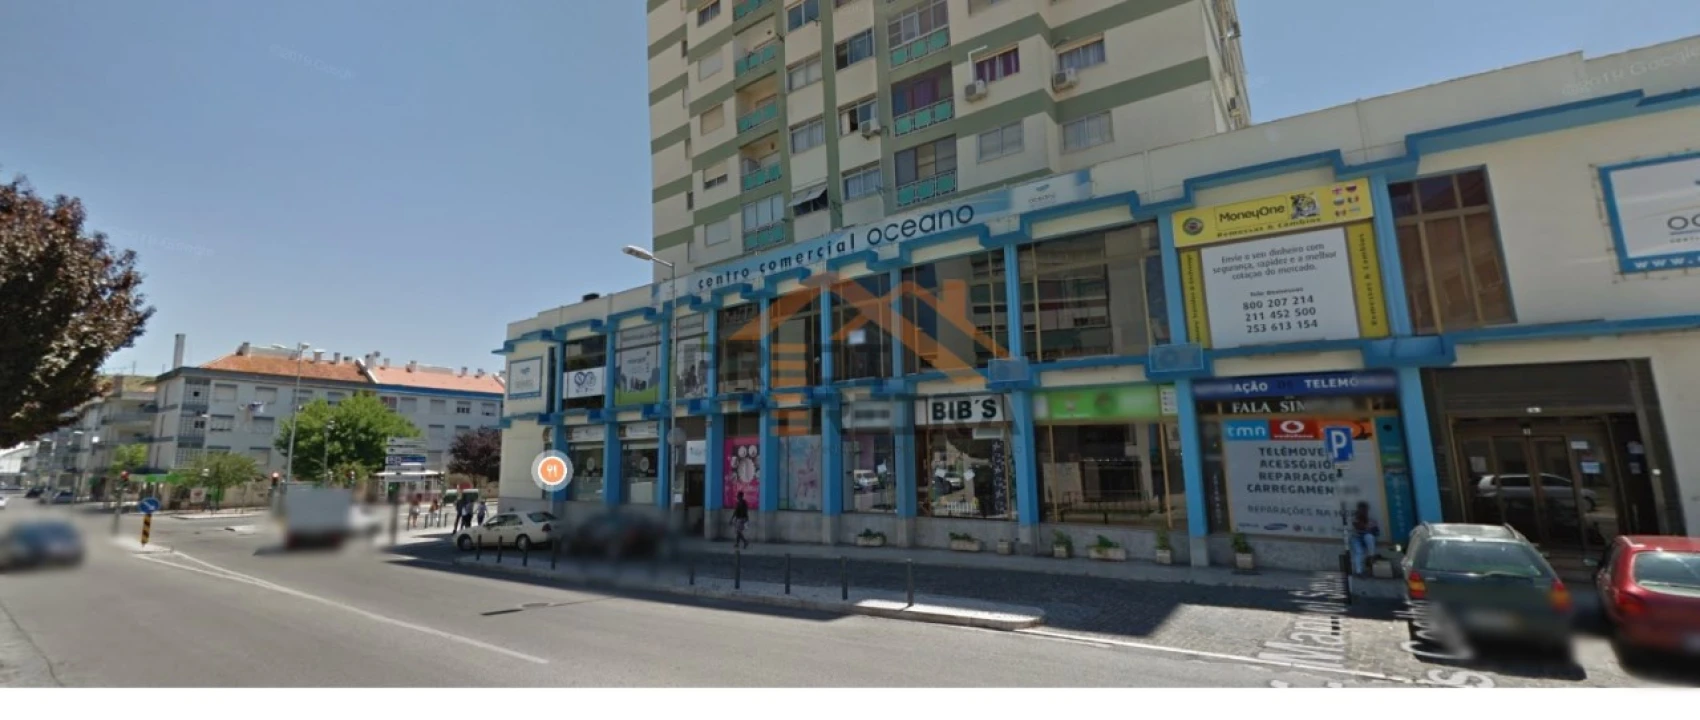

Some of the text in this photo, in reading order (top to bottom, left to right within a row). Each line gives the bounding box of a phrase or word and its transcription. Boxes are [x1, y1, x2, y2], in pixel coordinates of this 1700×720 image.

[1219, 205, 1285, 222] MoneyOne
[698, 203, 974, 289] centro comercial oceano
[1269, 246, 1304, 257] dinheiro
[1306, 244, 1324, 252] com
[1306, 251, 1337, 260] melhor
[1265, 268, 1275, 276] do
[1243, 295, 1314, 310] 800 207 214
[1245, 307, 1316, 322] 211 452 500
[1246, 319, 1318, 333] 253 613 154
[1228, 381, 1268, 394] AÇÃO
[1304, 376, 1362, 389] TELEMO
[1232, 401, 1271, 413] FALA
[1227, 425, 1266, 437] tmn
[1331, 429, 1347, 458] P
[1259, 471, 1337, 483] REPARAÇÕE
[1246, 483, 1336, 495] CARREGAMEN
